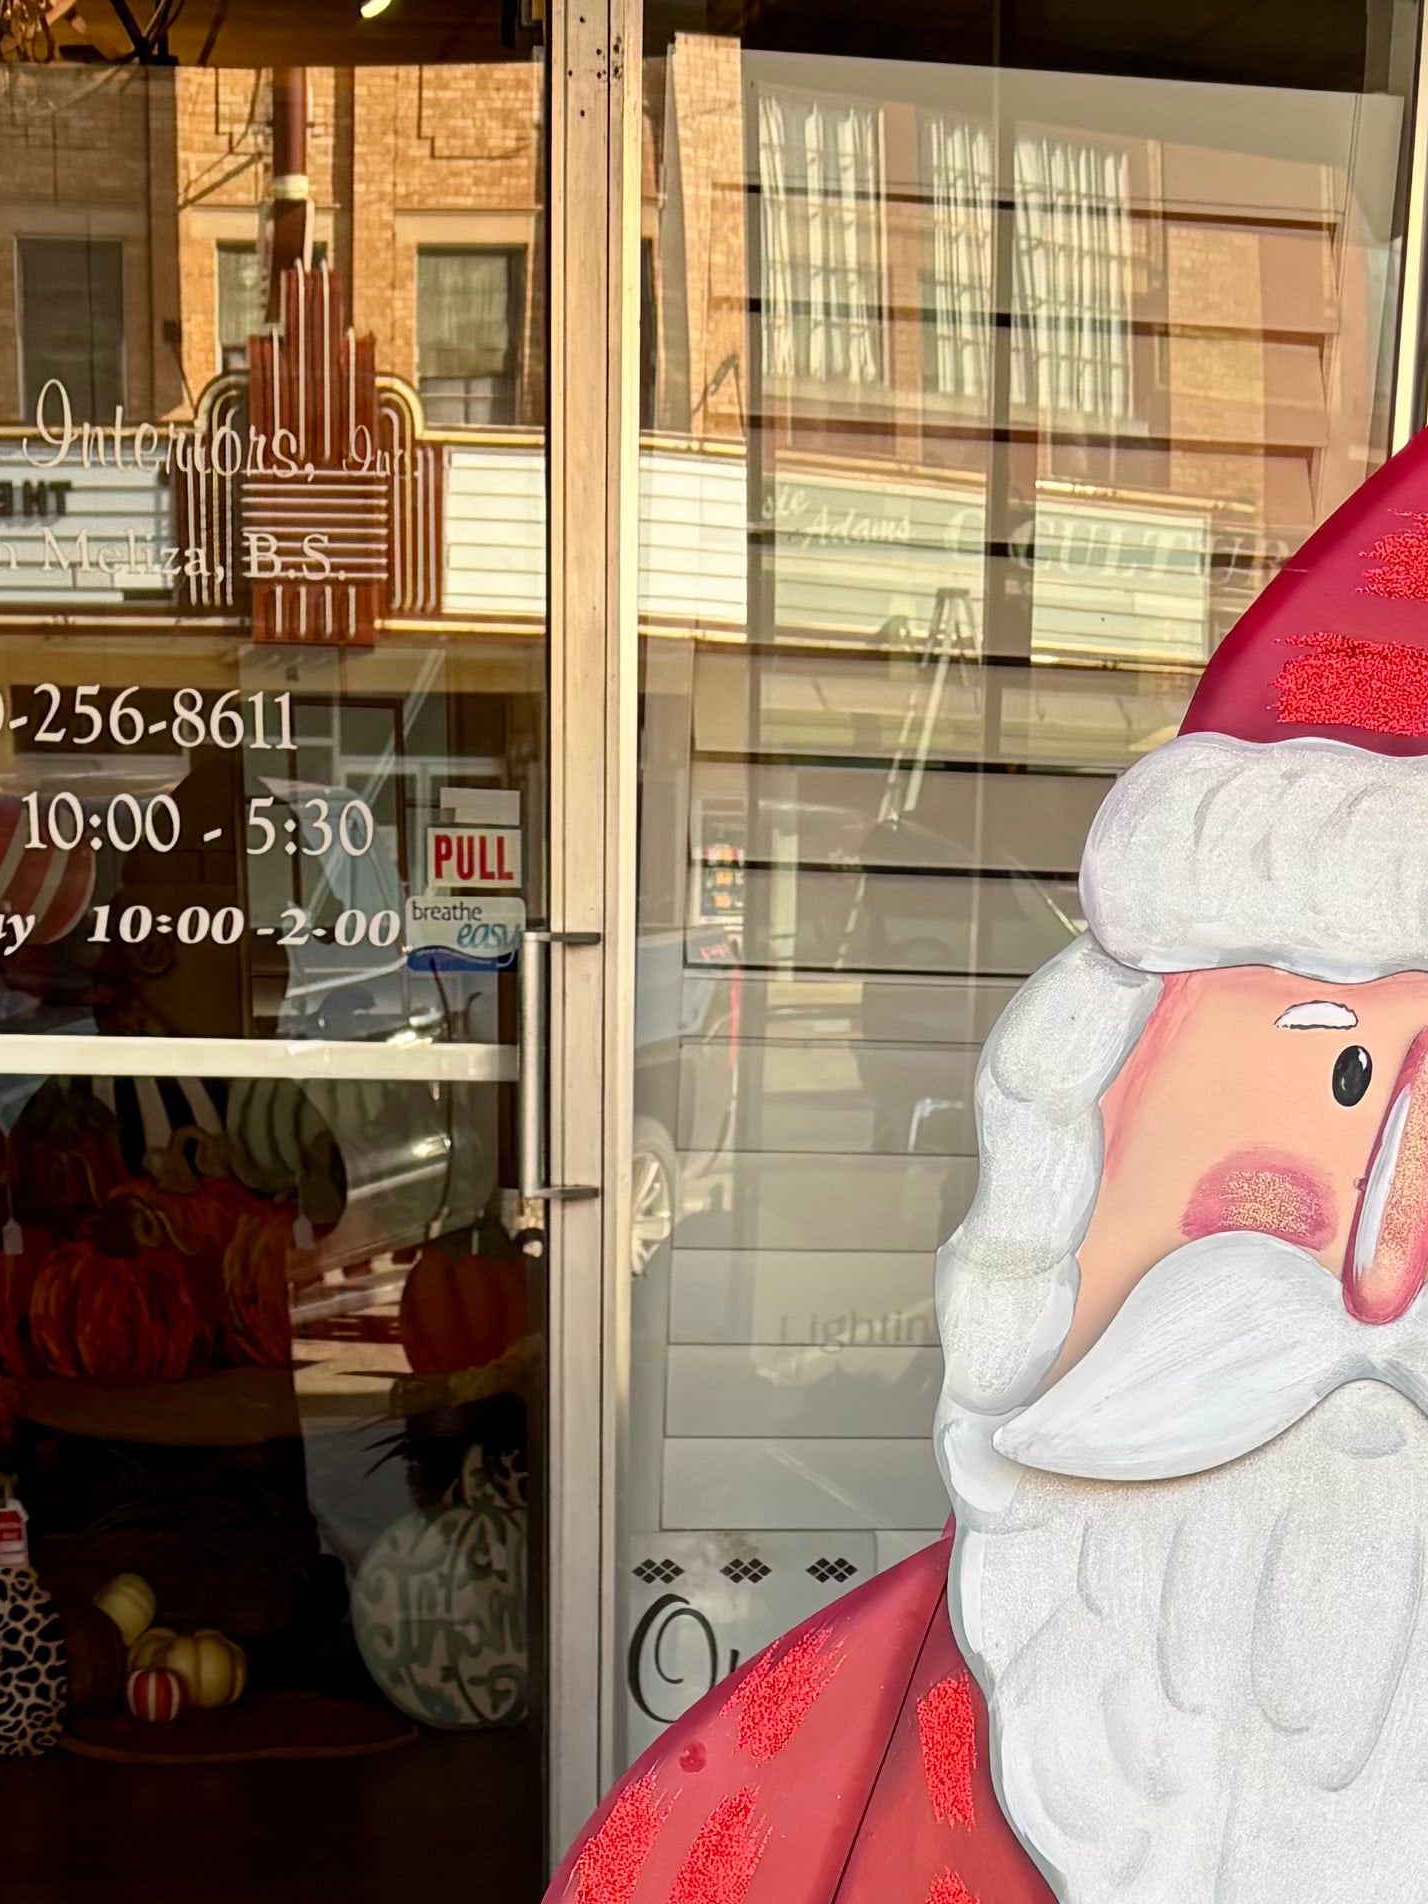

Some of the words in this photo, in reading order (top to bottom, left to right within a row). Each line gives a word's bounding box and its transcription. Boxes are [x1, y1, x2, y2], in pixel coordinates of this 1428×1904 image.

[22, 378, 315, 482] Interiors,
[43, 526, 226, 583] Meliza,
[242, 532, 347, 582] B.S.
[21, 789, 182, 854] 10:00
[246, 797, 374, 857] 5:30
[433, 833, 514, 881] PULL
[412, 900, 483, 922] breathe
[456, 922, 521, 955] easy
[780, 1307, 932, 1354] Lightin
